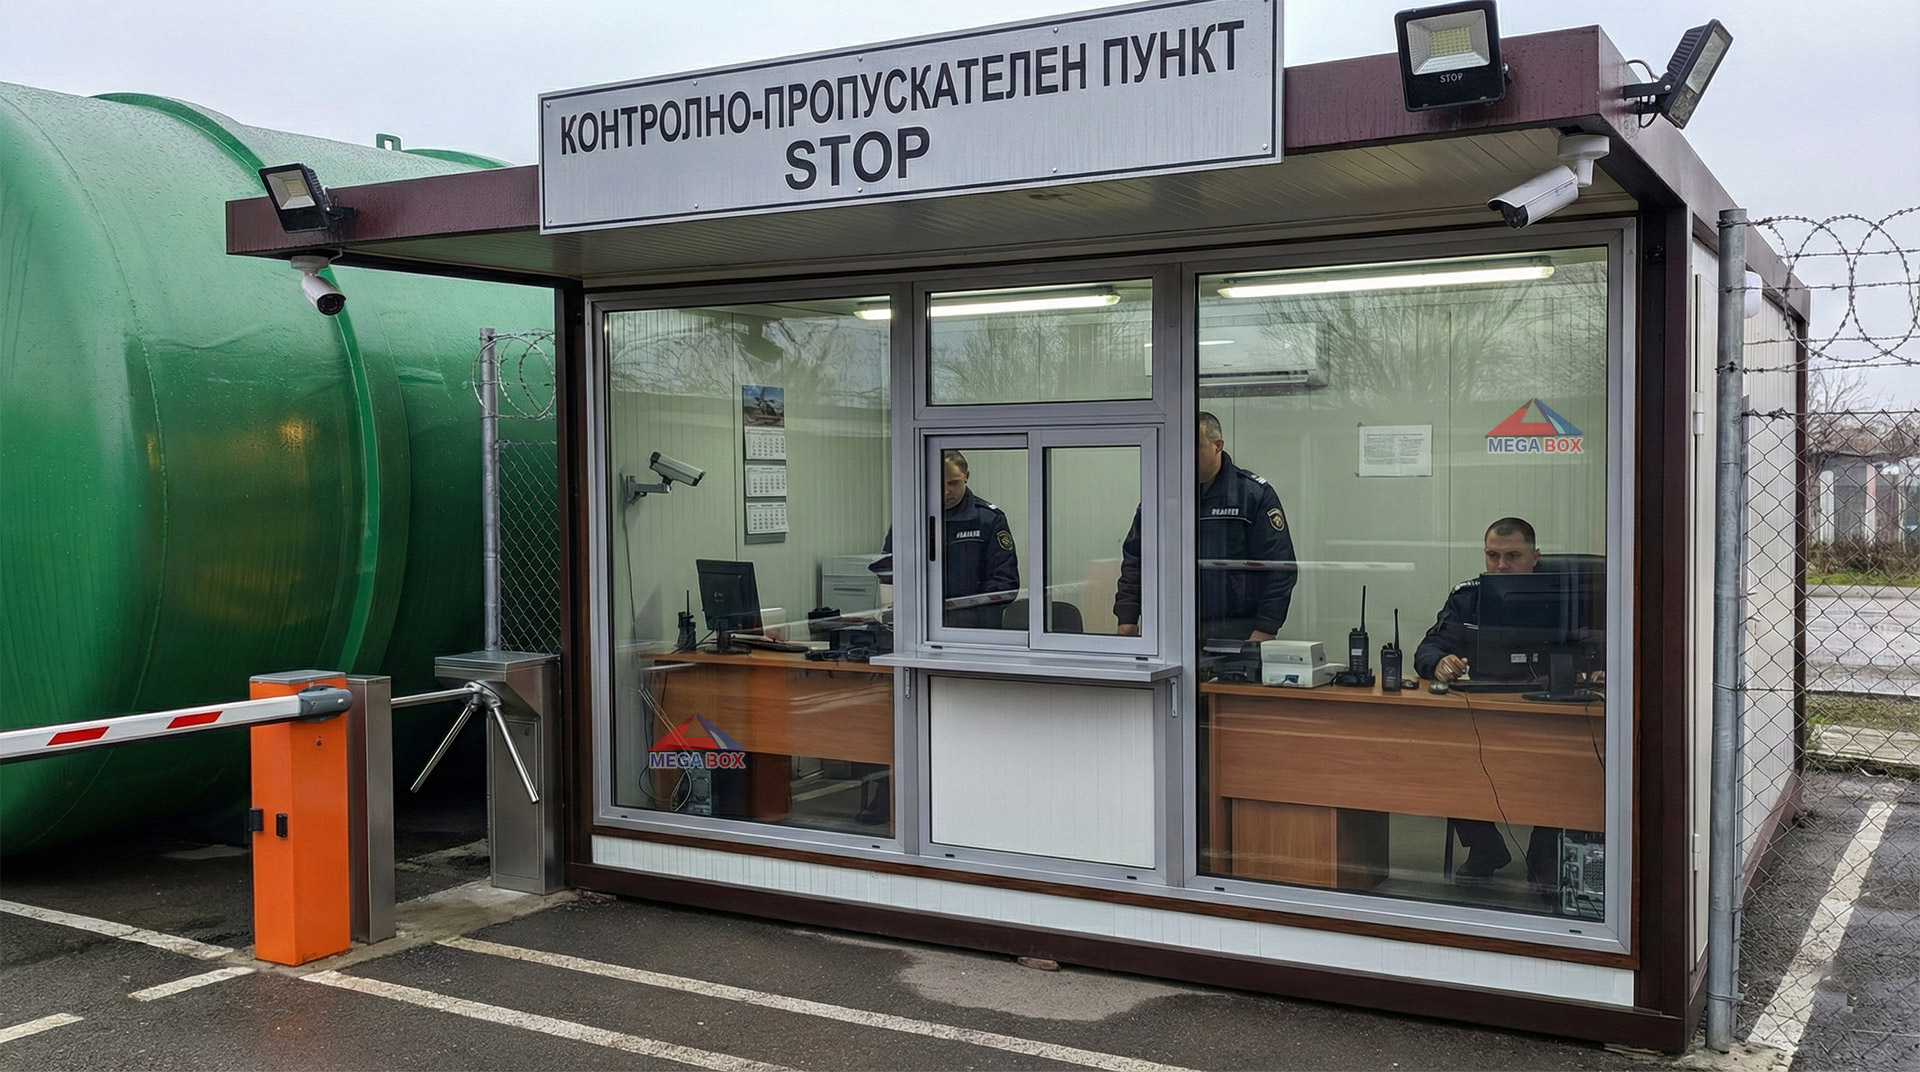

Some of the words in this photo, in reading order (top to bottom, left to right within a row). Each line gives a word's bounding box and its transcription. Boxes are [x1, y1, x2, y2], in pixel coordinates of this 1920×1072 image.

[560, 43, 1087, 155] КОНТРОЛНО-ПРОПУСКАТЕЛЕН
[1103, 20, 1245, 85] ПУНКТ
[1440, 72, 1463, 83] STOP
[785, 126, 930, 191] STOP
